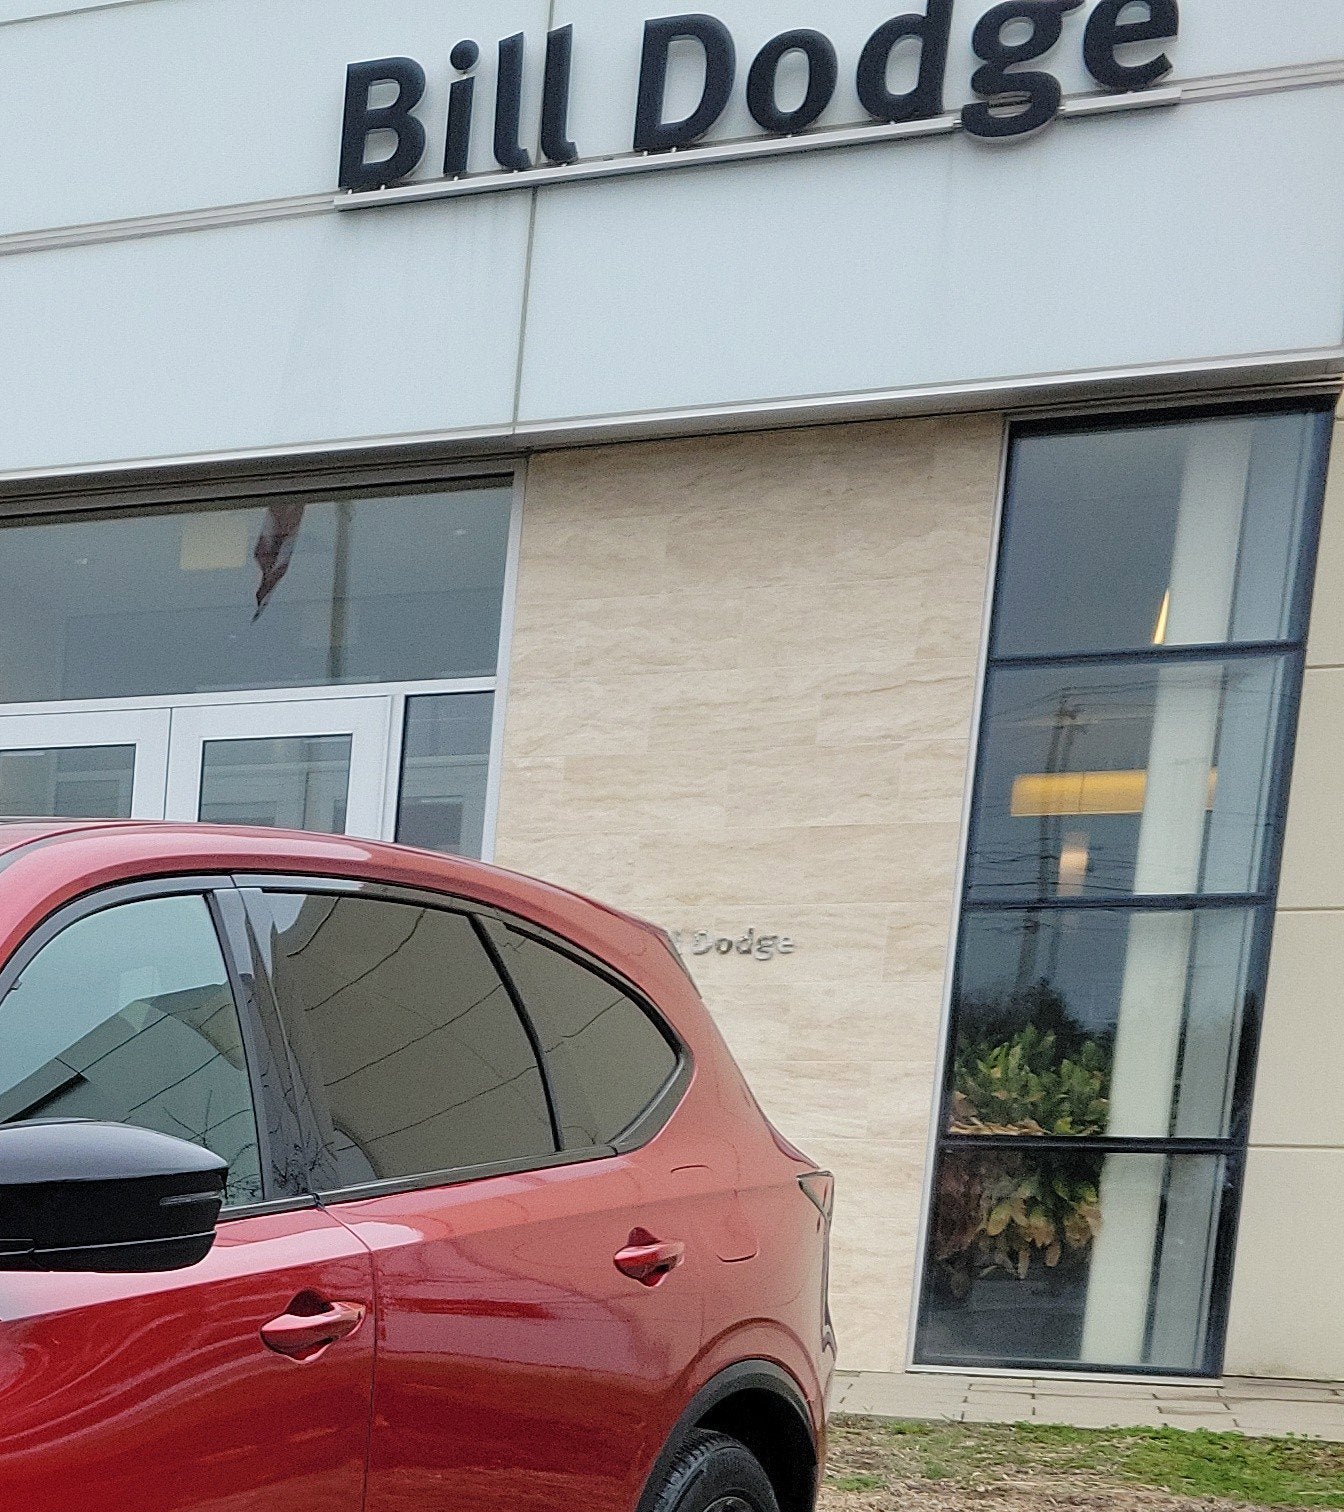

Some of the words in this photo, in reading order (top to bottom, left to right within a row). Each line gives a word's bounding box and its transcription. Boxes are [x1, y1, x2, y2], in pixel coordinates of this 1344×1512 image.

[338, 23, 578, 190] Bill
[632, 0, 1179, 139] Dodge
[692, 927, 795, 961] Dodge
